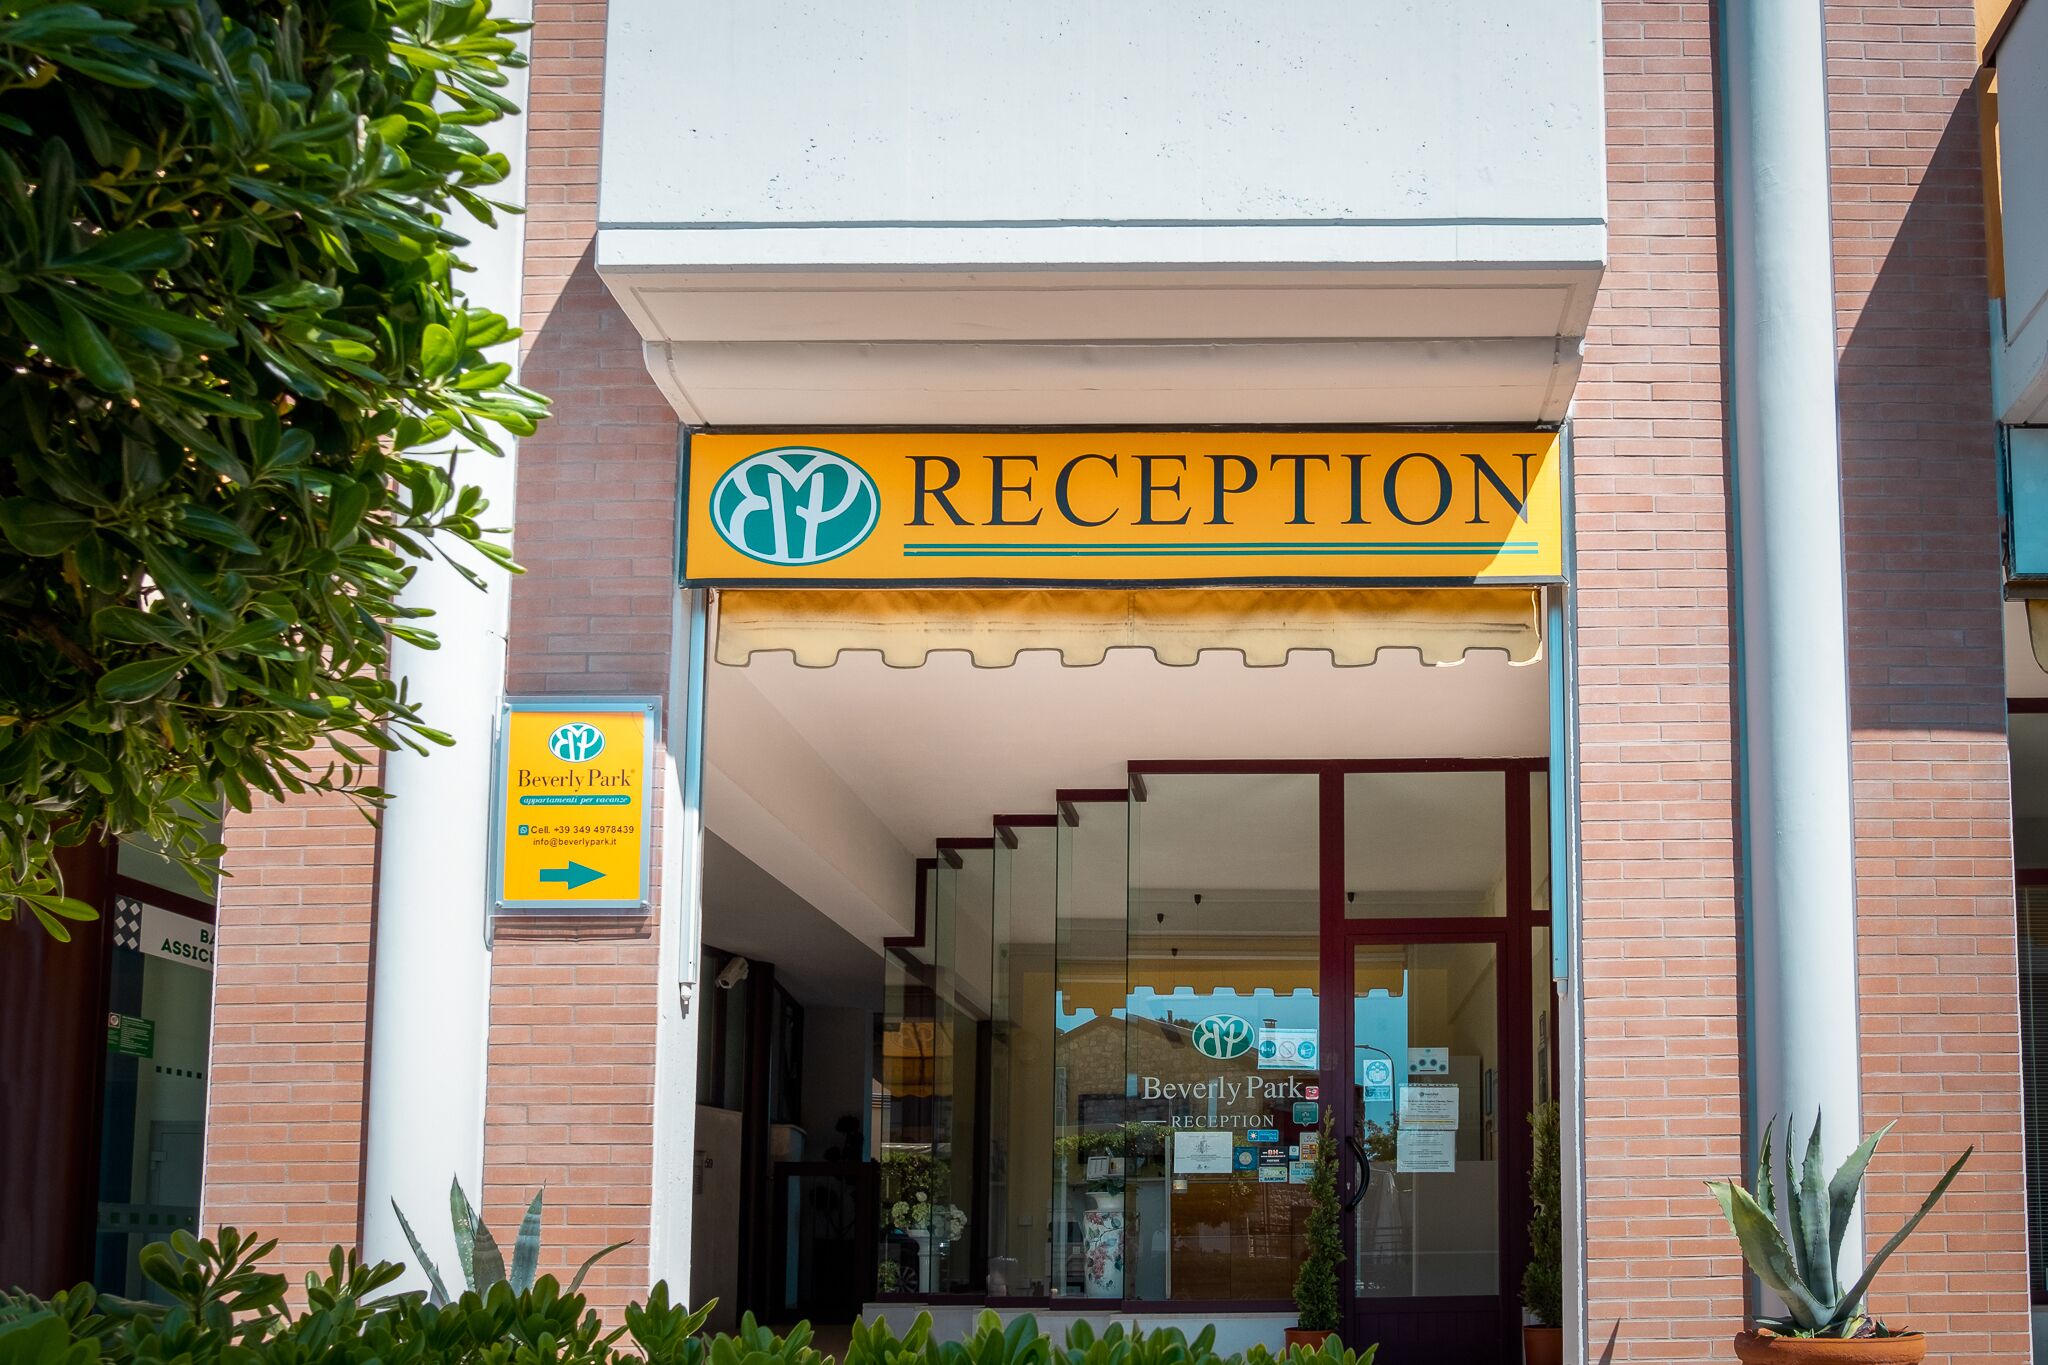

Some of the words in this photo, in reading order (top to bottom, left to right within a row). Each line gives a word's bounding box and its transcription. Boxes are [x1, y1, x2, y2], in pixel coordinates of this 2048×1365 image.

[903, 452, 1539, 528] RECEPTION
[518, 769, 584, 792] Beverly
[587, 768, 632, 786] Park
[523, 796, 578, 805] appartamenti
[579, 797, 593, 805] per
[530, 825, 551, 834] Cell.
[553, 825, 570, 834] +39
[573, 825, 591, 834] 349
[593, 825, 635, 834] 4978439
[533, 838, 617, 847] info@beverlypark.it
[1142, 1075, 1242, 1106] Beverly
[1245, 1075, 1303, 1099] Park
[1171, 1114, 1275, 1128] RECEPTION
